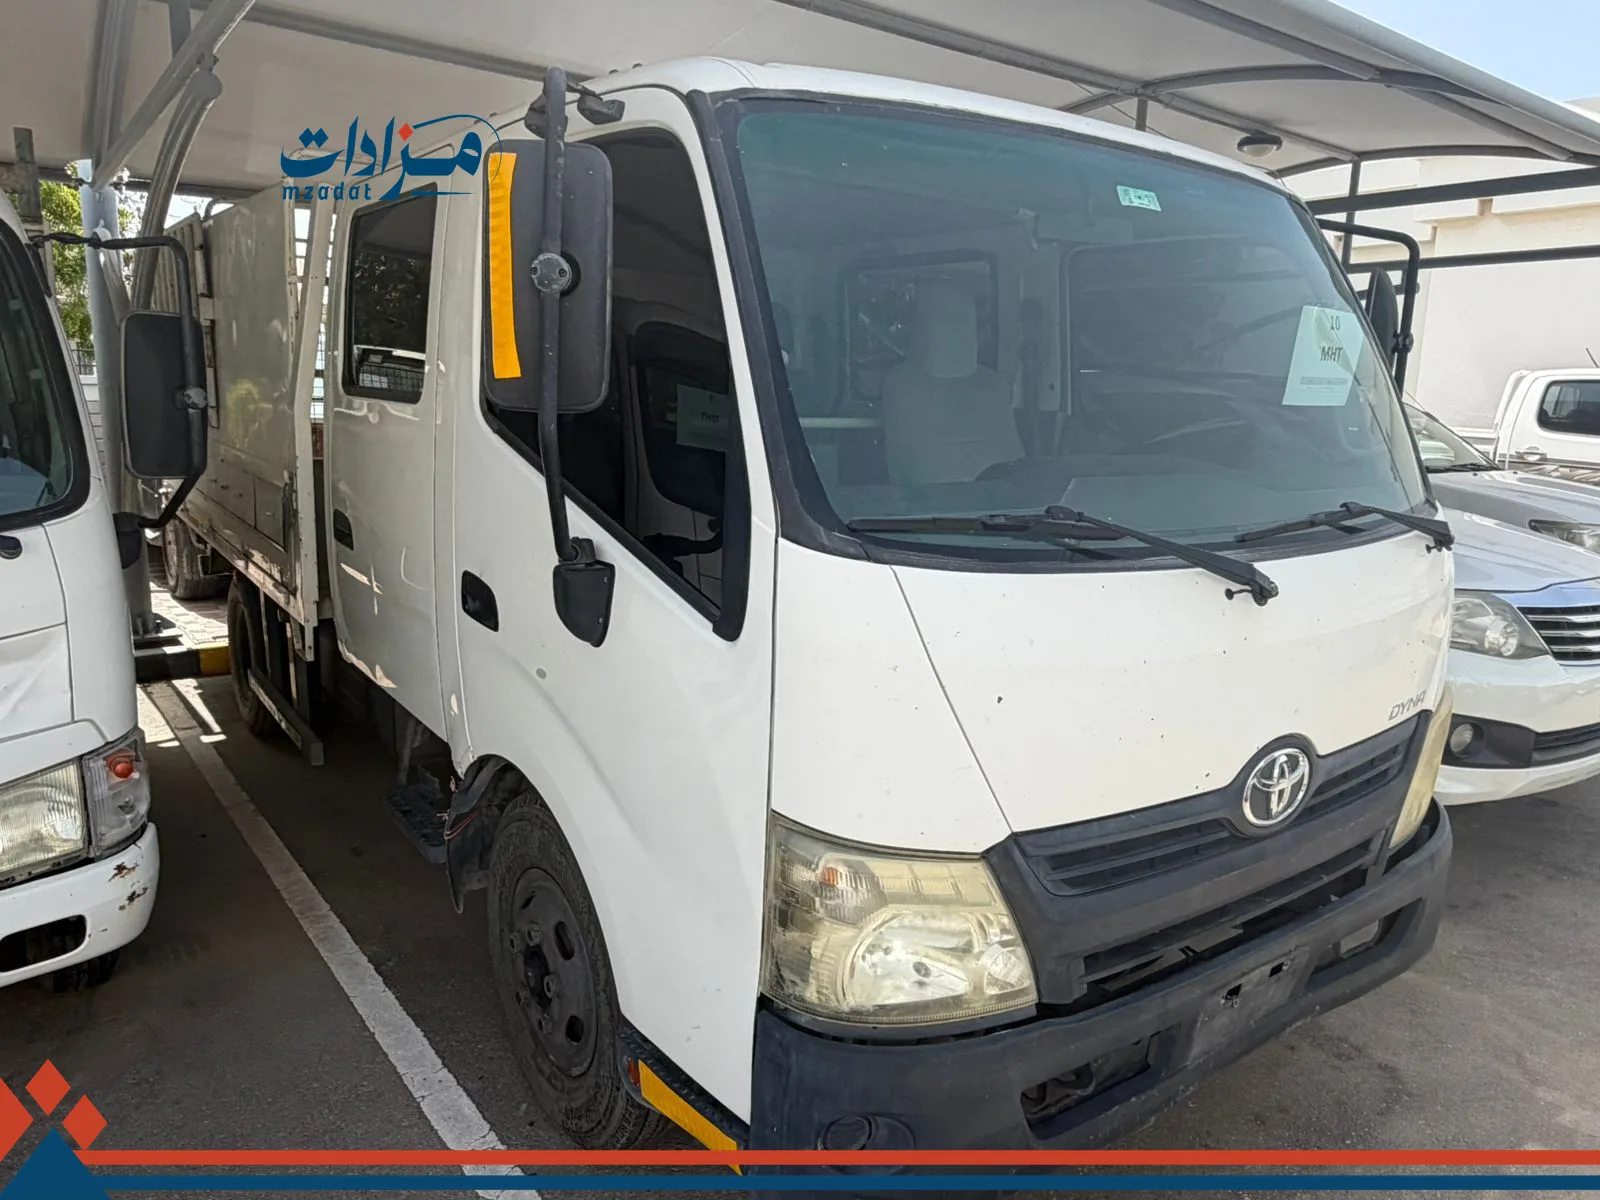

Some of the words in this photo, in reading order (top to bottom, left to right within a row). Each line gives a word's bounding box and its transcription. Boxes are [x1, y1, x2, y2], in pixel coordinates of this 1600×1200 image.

[1330, 315, 1341, 331] 10
[1320, 345, 1344, 363] MHT
[1388, 690, 1426, 721] DYNA
